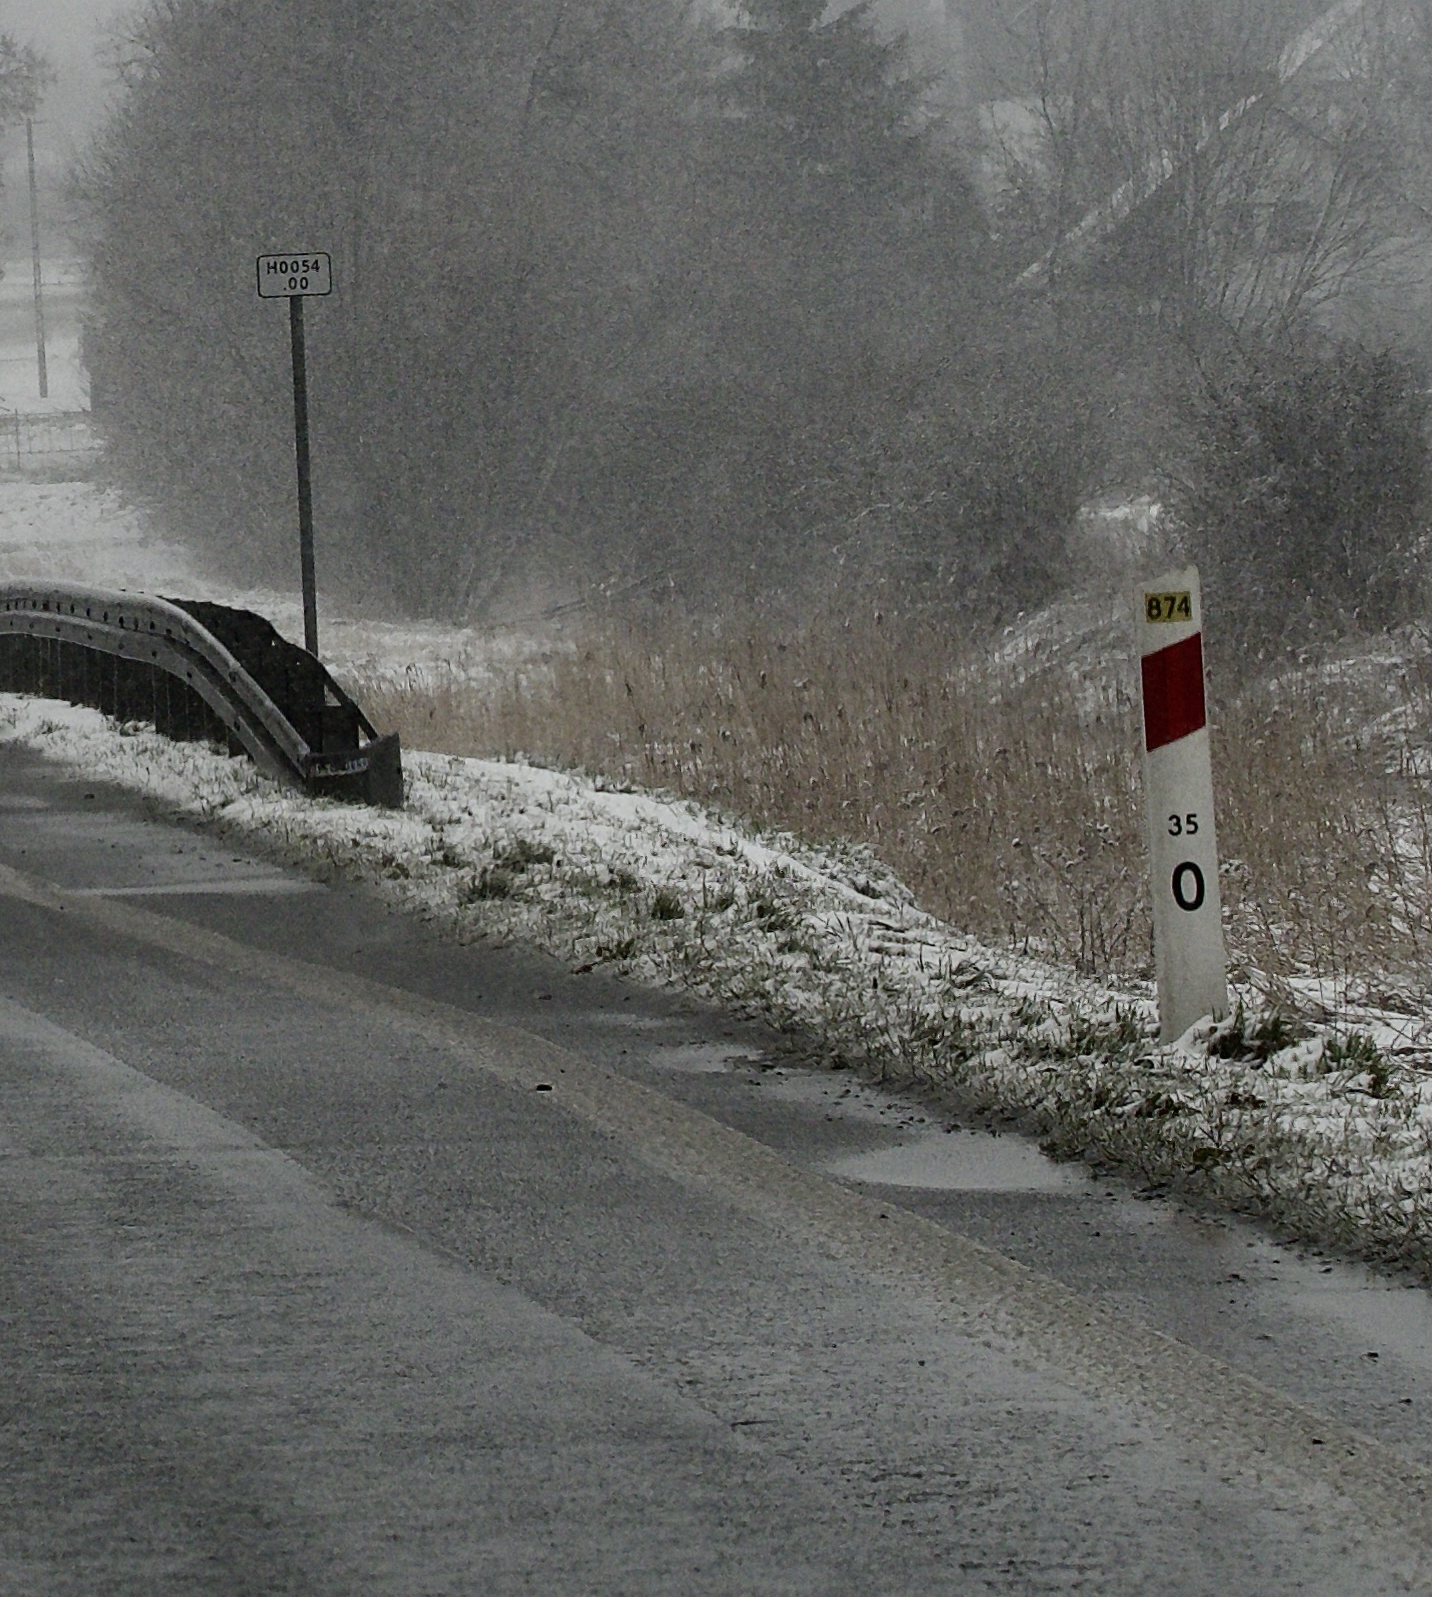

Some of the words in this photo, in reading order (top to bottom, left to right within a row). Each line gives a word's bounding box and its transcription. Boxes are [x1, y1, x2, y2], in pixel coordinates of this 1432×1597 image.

[1147, 596, 1190, 620] 874
[1168, 814, 1198, 836] 35
[1172, 861, 1205, 911] 0
